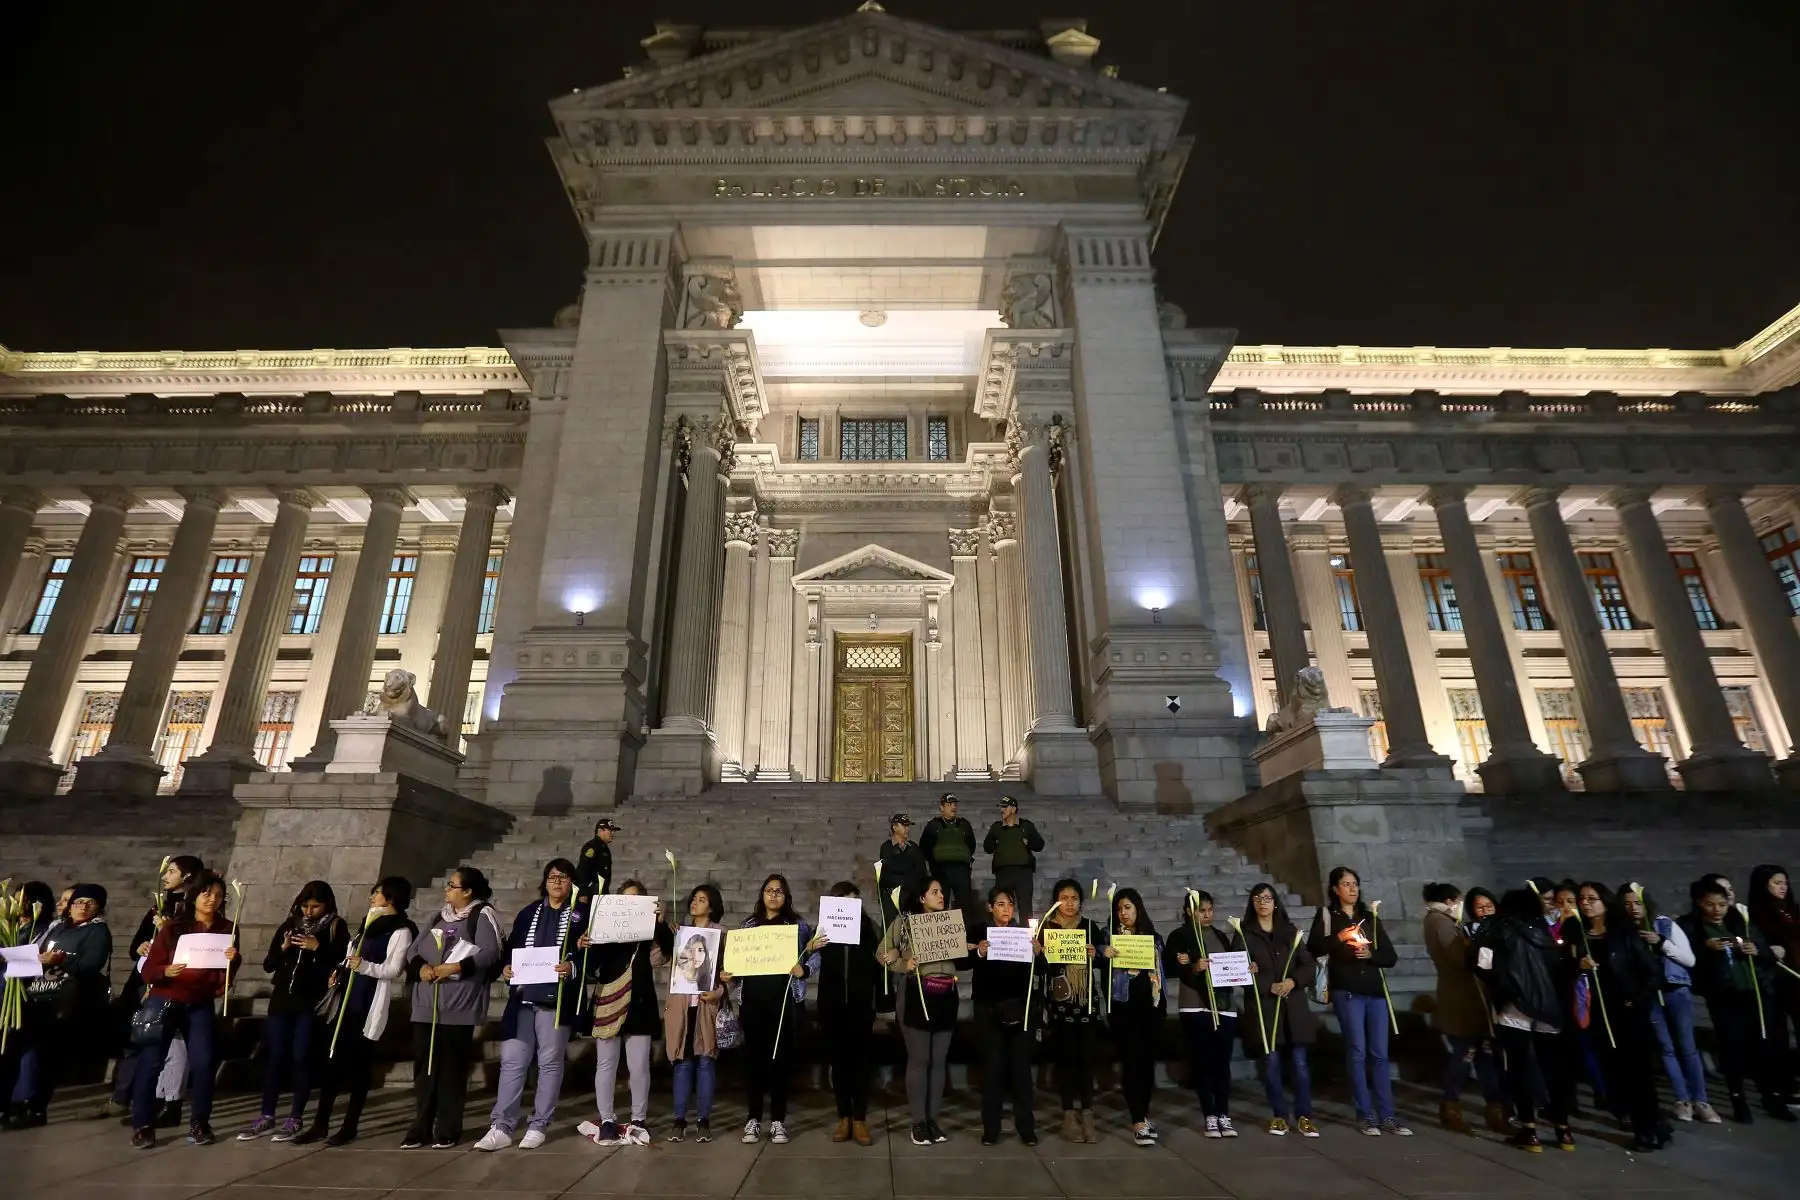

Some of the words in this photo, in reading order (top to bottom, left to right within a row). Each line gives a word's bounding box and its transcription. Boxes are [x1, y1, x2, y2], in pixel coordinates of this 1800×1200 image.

[854, 178, 885, 197] DE
[614, 920, 630, 928] NO
[920, 912, 951, 925] LLAMABA
[914, 926, 934, 939] EYVI
[1047, 931, 1058, 940] NO
[918, 950, 950, 962] JUSTICIA
